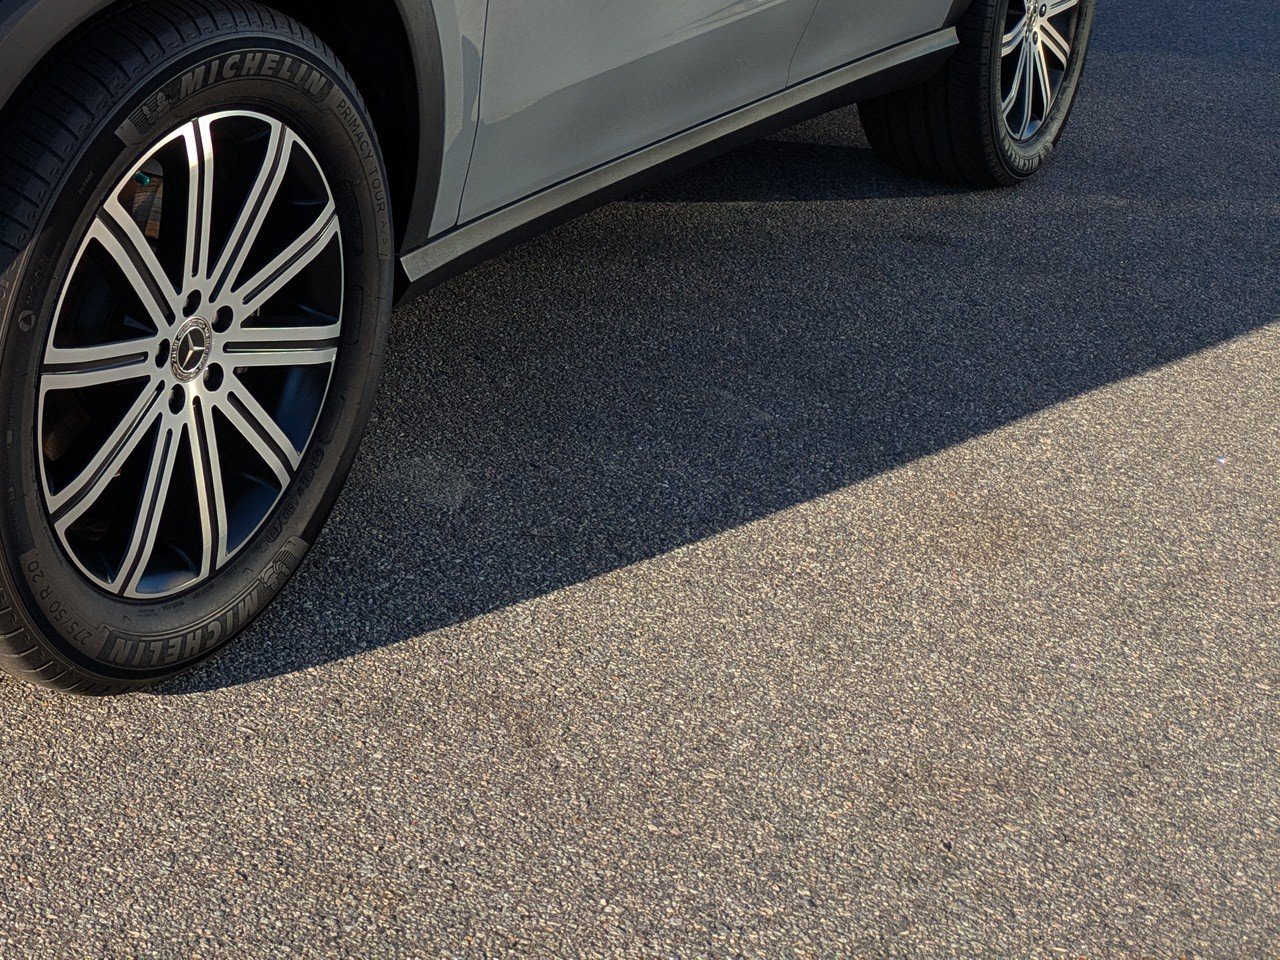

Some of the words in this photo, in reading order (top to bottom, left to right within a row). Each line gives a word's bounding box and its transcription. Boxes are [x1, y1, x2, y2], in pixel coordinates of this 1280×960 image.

[177, 51, 328, 101] MICHELIN
[336, 99, 374, 160] PRIMACY
[369, 165, 386, 213] TOUR
[27, 561, 45, 583] 20
[40, 585, 53, 600] R
[48, 600, 92, 645] 275/50
[107, 589, 259, 666] MICHELIN
